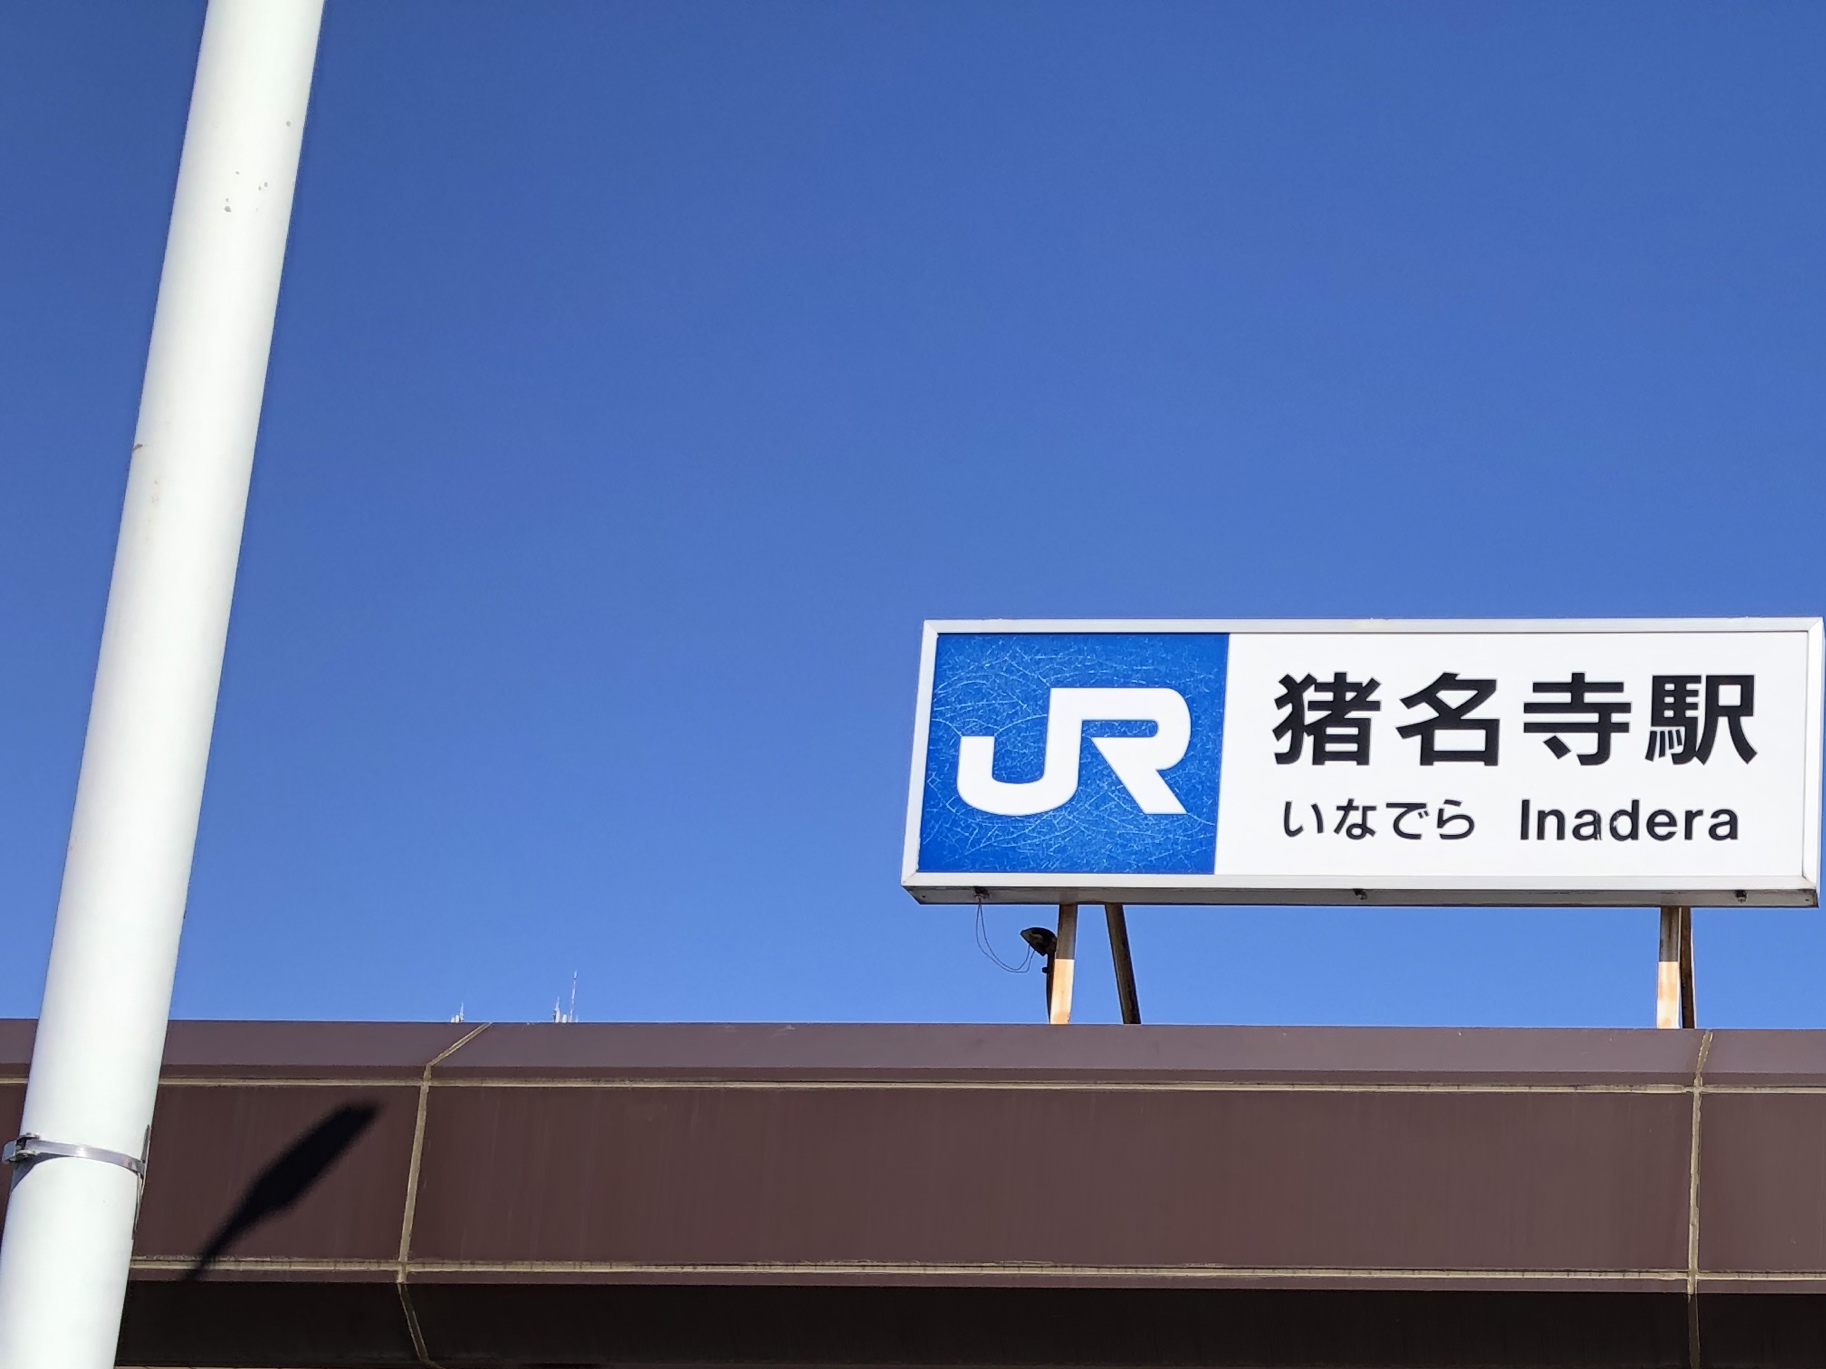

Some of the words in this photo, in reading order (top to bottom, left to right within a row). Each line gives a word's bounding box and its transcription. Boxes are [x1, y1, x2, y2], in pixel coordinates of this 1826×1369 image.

[956, 687, 1192, 816] JR
[1273, 671, 1758, 767] 猪名寺駅
[1283, 798, 1476, 841] いなでら
[1520, 799, 1739, 842] Inadera
